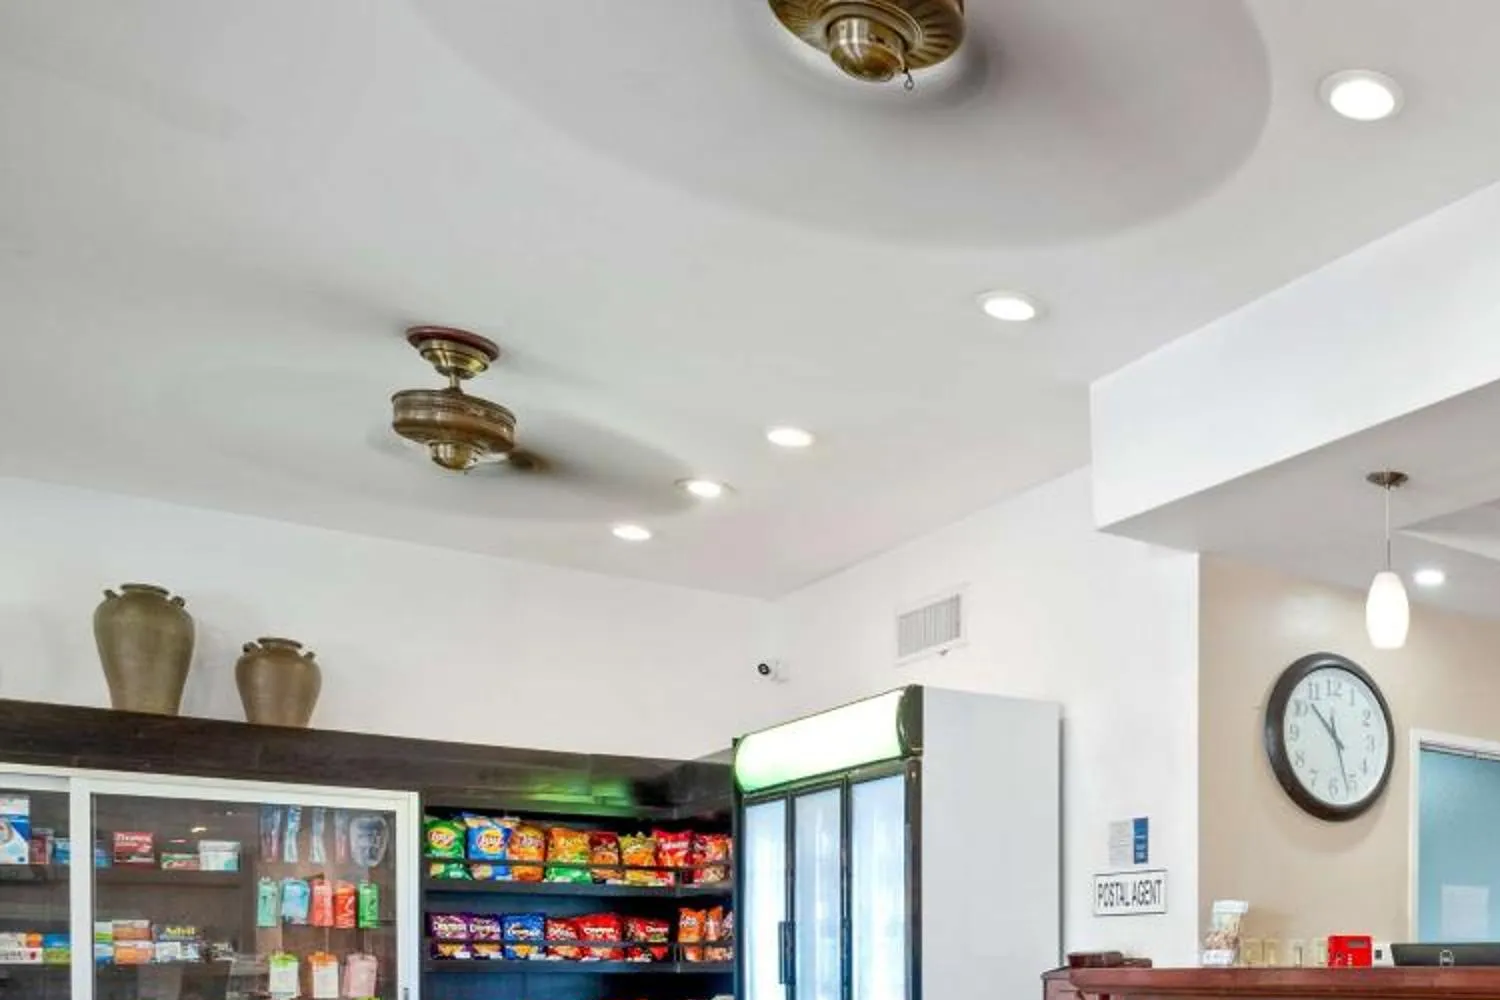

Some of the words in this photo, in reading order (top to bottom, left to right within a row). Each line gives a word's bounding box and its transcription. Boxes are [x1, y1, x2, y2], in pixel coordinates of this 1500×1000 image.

[1308, 681, 1321, 700] 11
[1327, 679, 1343, 697] 12
[1362, 708, 1372, 727] 2
[1289, 723, 1300, 741] 9
[1365, 733, 1375, 754] 3
[1294, 750, 1305, 769] 8
[1308, 768, 1319, 787] 7
[1328, 777, 1339, 796] 6
[1098, 881, 1130, 907] POSTAL
[1131, 879, 1162, 906] AGENT
